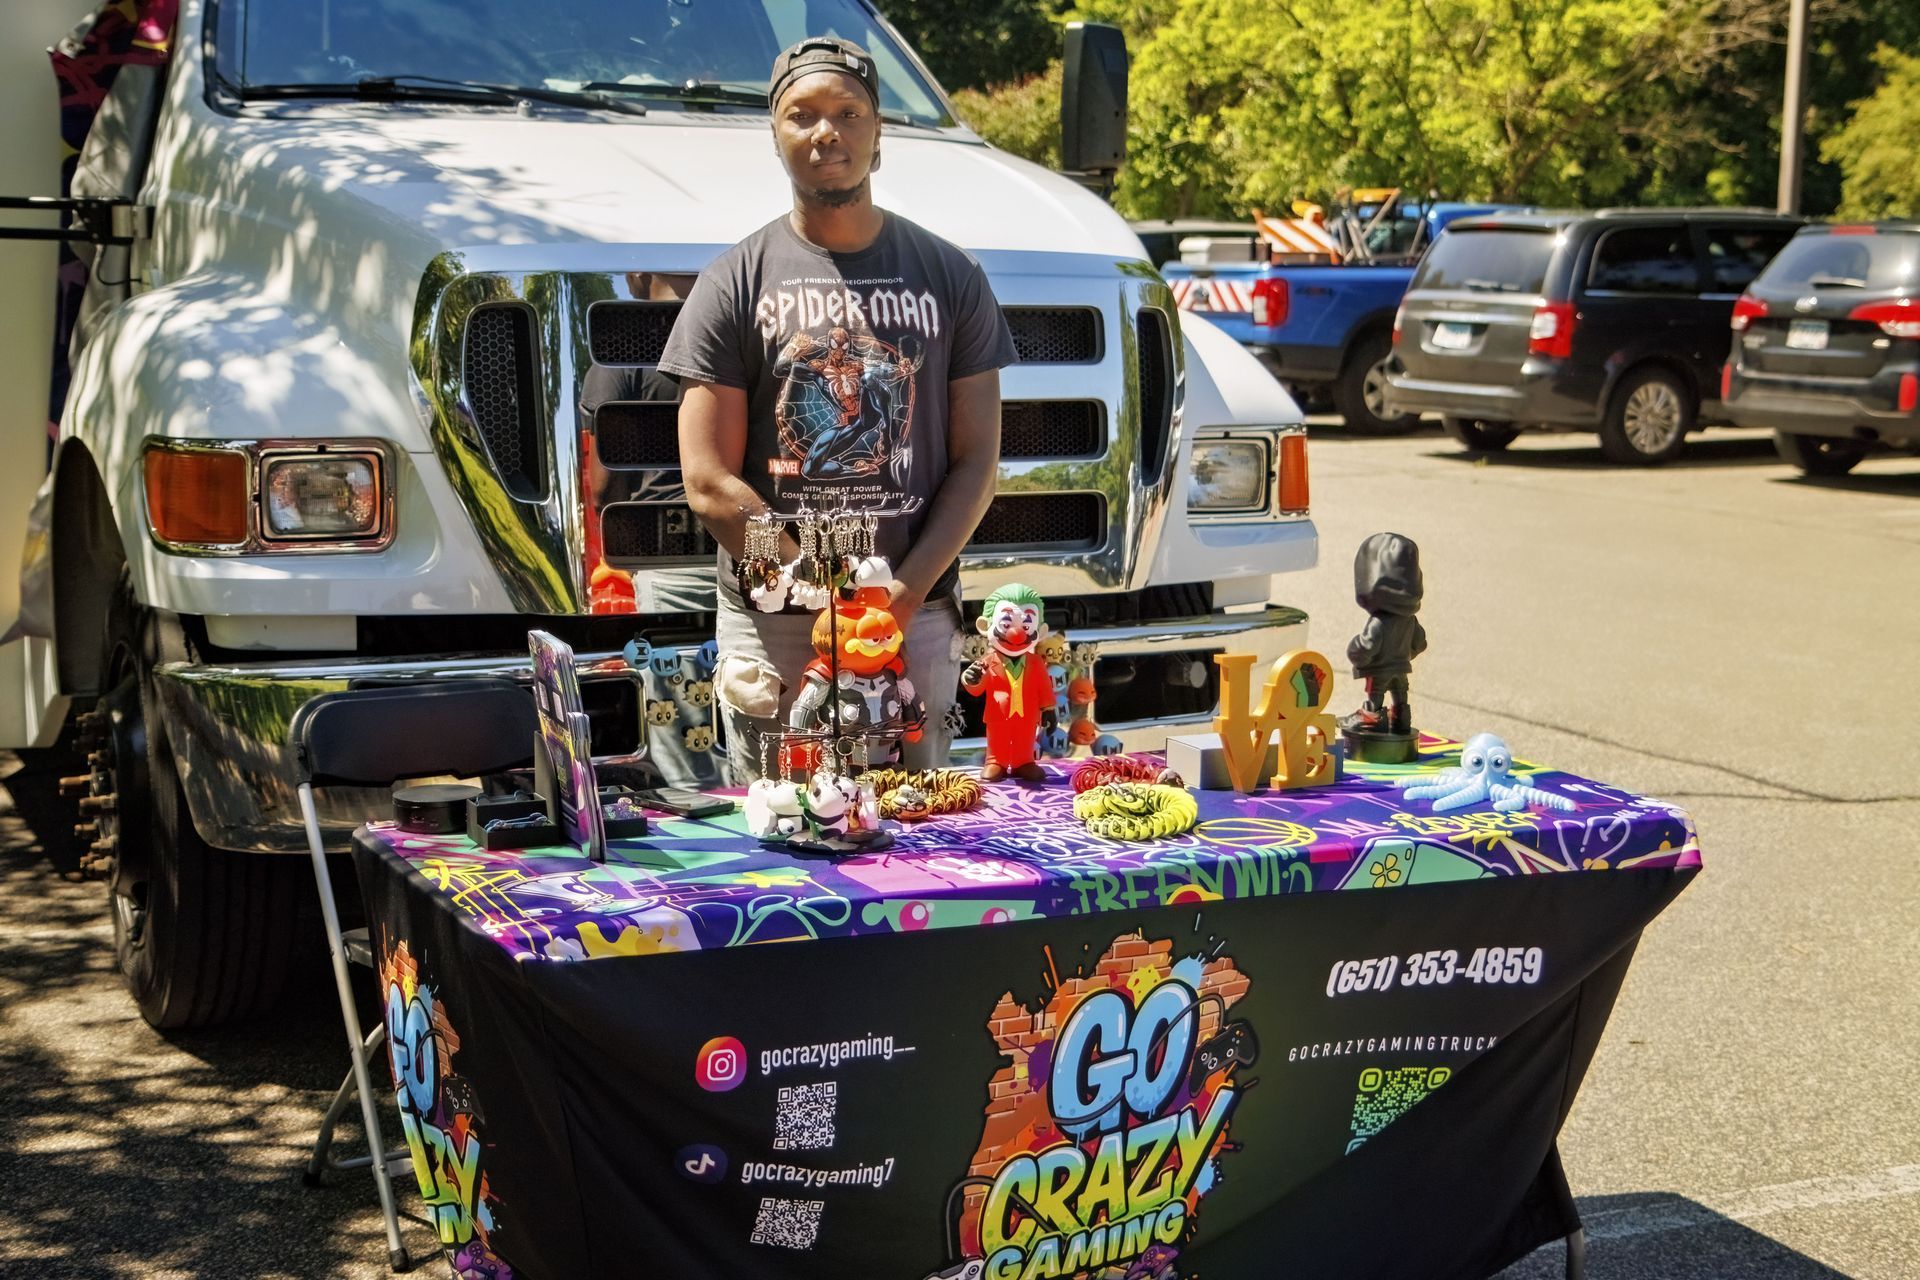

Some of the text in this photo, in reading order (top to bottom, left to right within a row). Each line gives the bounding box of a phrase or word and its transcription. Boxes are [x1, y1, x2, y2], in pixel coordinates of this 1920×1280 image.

[844, 277, 904, 285] NEIGHBORHOOD
[769, 459, 800, 474] MARVEL
[782, 492, 809, 500] COMES
[1326, 947, 1543, 998] (651) 353-4859
[1052, 982, 1193, 1134] GO
[1288, 1036, 1497, 1062] GOCRAZYGAMINGTRUCK
[740, 1157, 895, 1188] gocrazygaming7
[981, 1087, 1234, 1260] CRAZY
[983, 1201, 1187, 1280] GAMING
